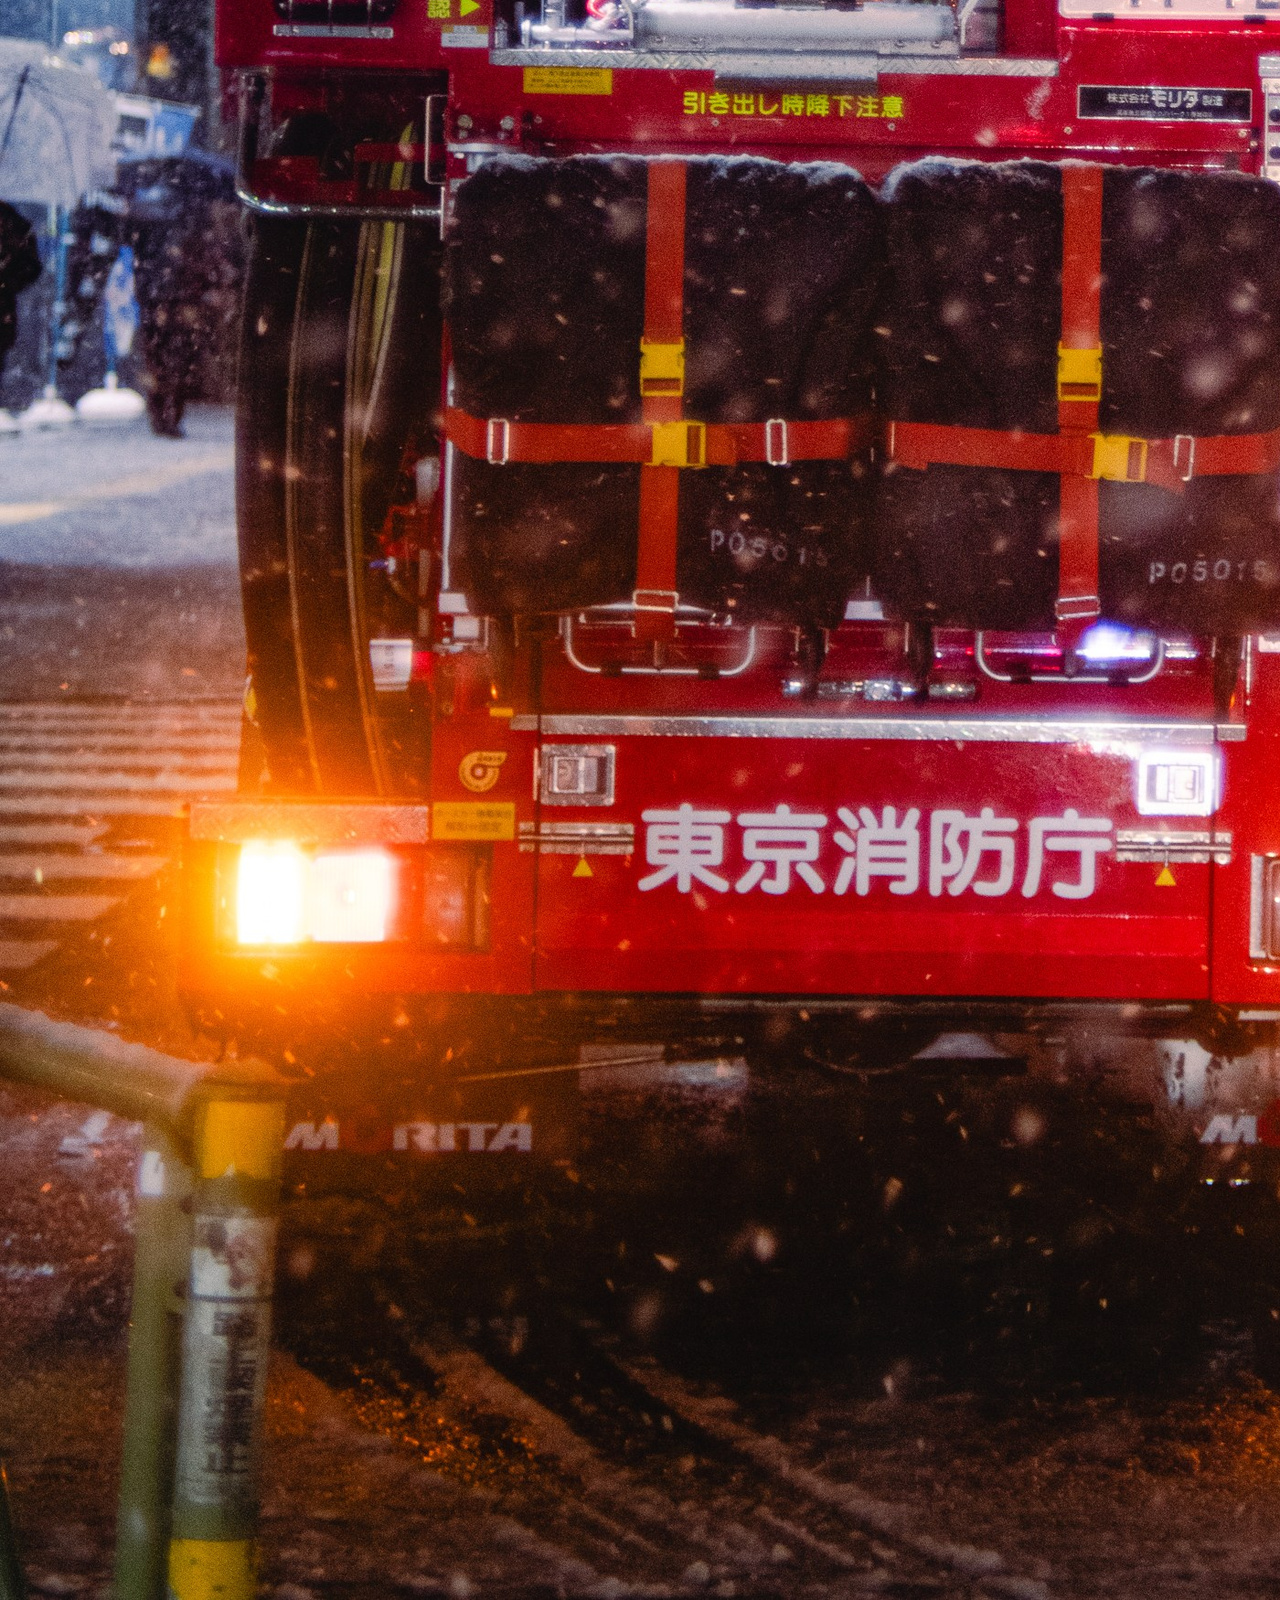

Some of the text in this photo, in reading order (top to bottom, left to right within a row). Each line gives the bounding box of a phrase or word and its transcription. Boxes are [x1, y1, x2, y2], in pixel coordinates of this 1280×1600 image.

[682, 91, 904, 118] 引き出し時降下注意
[638, 804, 1114, 899] 東京消防庁
